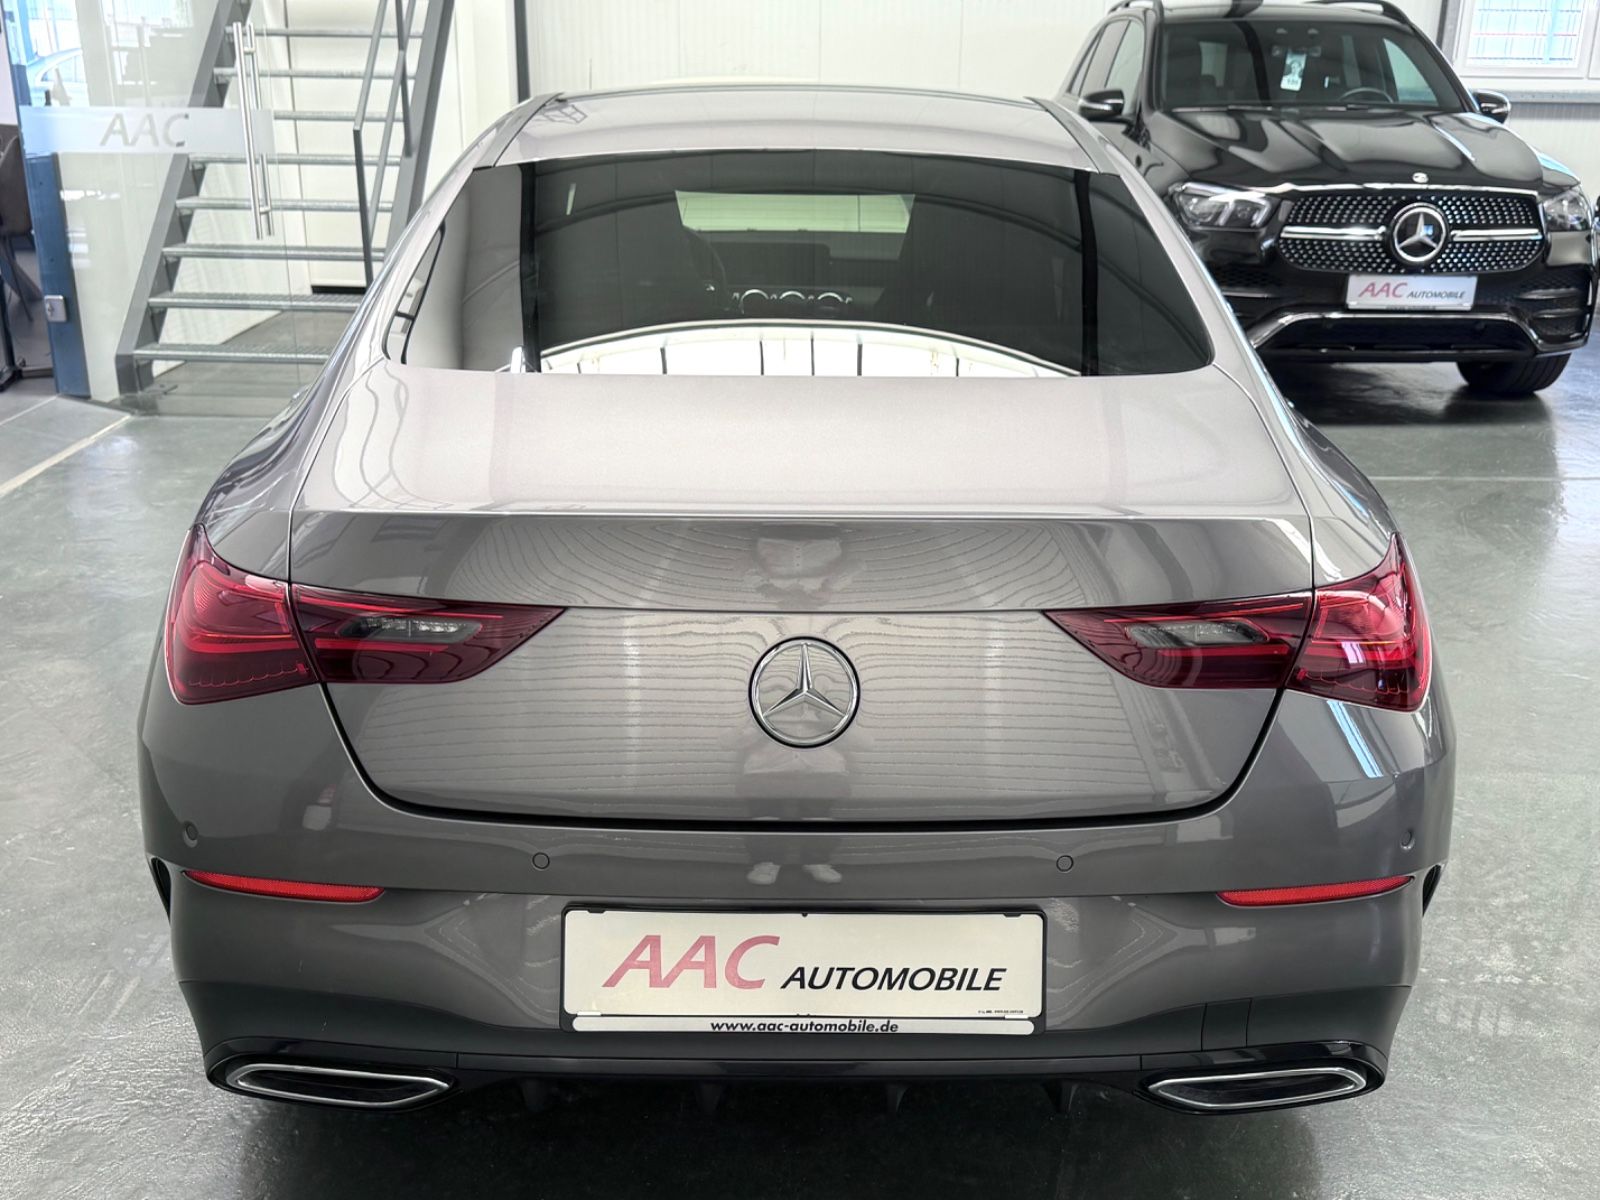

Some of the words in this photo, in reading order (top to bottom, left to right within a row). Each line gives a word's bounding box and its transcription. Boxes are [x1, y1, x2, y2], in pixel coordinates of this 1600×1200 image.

[99, 113, 189, 147] AAC
[1358, 281, 1408, 298] AAC
[1406, 291, 1466, 299] AUTOMOBILE
[602, 934, 780, 989] AAC
[781, 967, 1007, 991] AUTOMOBILE
[710, 1019, 899, 1034] www.aac-automobile.de
